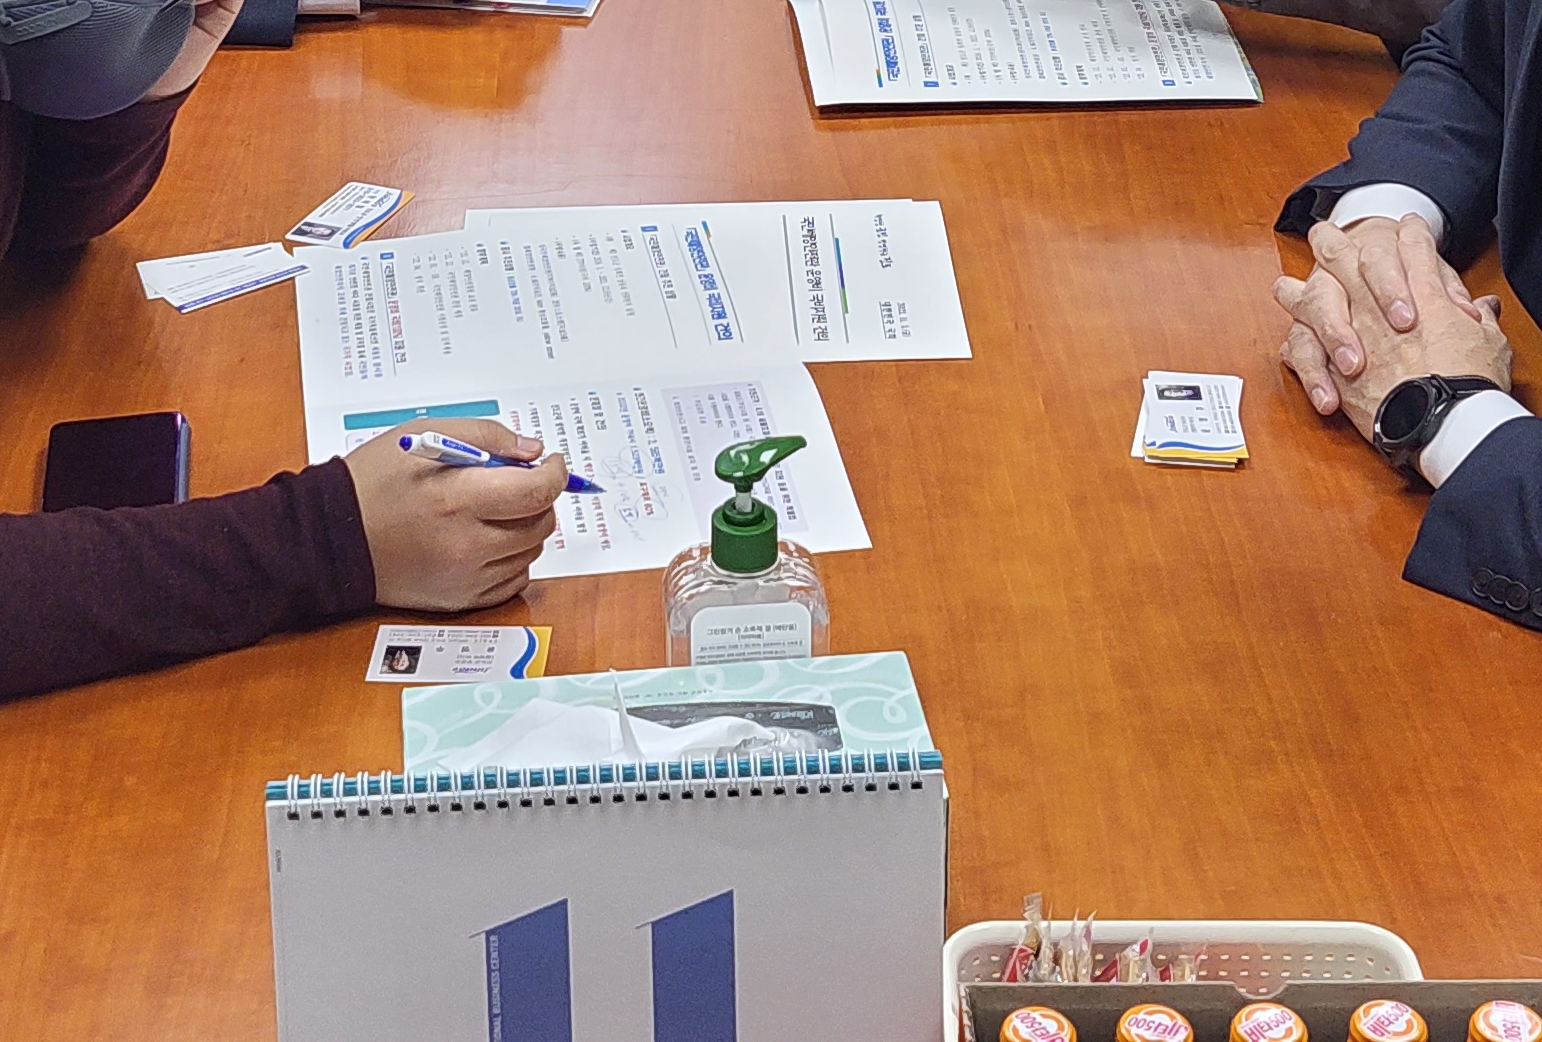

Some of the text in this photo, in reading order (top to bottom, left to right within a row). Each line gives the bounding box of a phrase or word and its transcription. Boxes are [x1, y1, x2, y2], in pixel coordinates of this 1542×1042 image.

[799, 216, 829, 341] 국민해양안전관 운영비 국비지원 건의
[696, 272, 718, 291] 운영비
[712, 323, 734, 341] 건의
[880, 301, 894, 324] 대한민국
[489, 934, 500, 970] CENTER
[491, 971, 502, 1015] BUSINESS
[1128, 1013, 1189, 1039] 비타500
[1242, 1009, 1293, 1042] 비타500
[1366, 1002, 1410, 1038] 비타500
